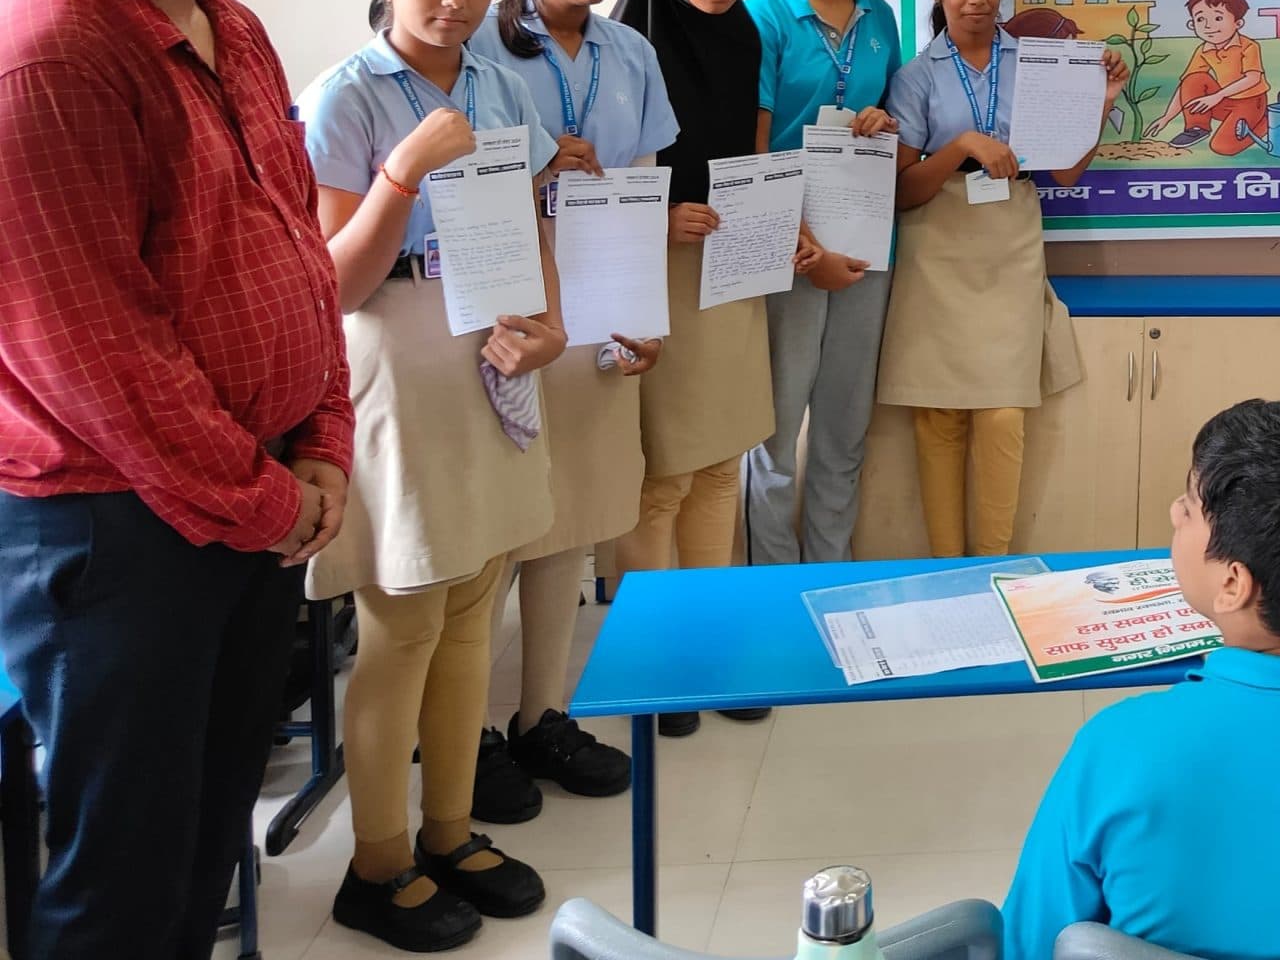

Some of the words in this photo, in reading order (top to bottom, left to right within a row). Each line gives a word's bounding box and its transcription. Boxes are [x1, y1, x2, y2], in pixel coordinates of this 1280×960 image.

[1128, 180, 1227, 200] नगर
[1076, 623, 1108, 635] हम
[1112, 611, 1171, 630] सबका
[1044, 640, 1090, 656] साफ
[1096, 633, 1147, 651] सुथरा
[1151, 625, 1173, 638] हो
